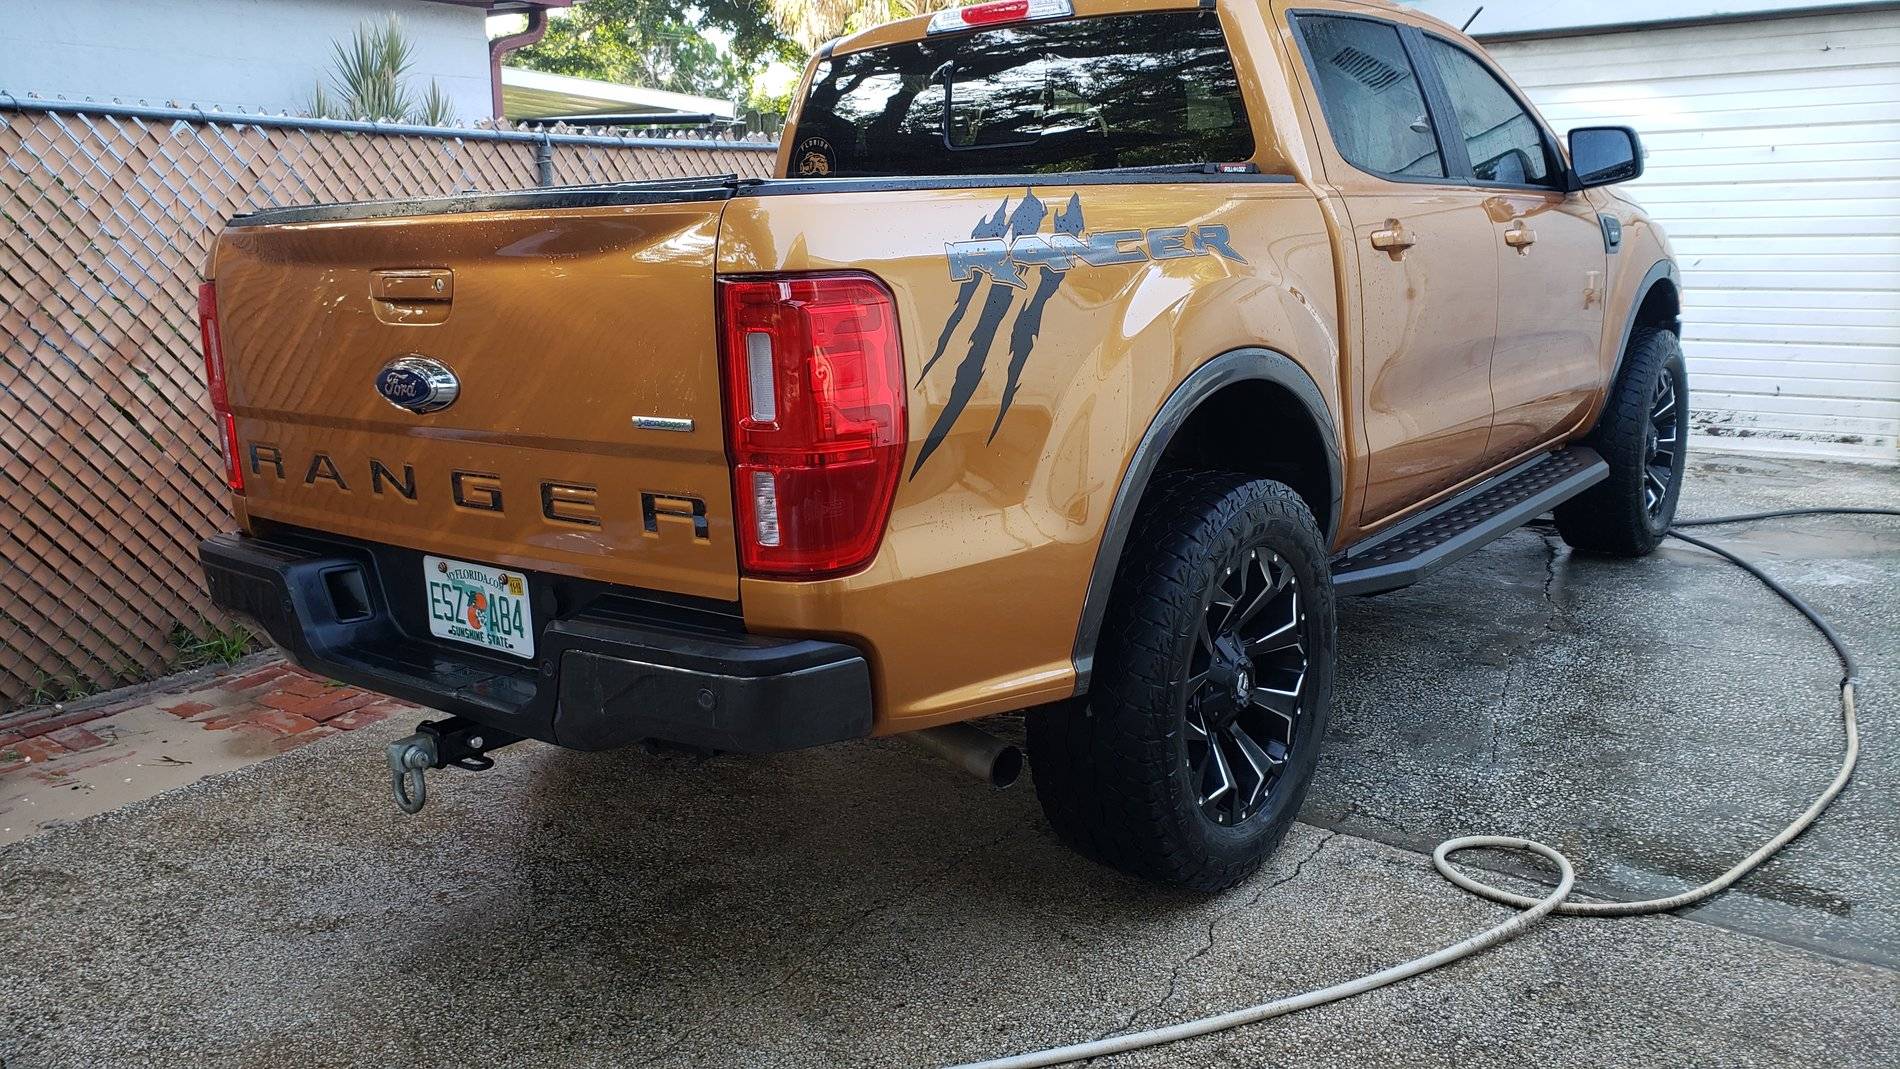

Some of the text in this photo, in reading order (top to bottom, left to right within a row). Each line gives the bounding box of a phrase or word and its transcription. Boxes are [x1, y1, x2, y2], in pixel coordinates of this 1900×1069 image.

[384, 372, 418, 397] Ford
[249, 442, 710, 543] RANGER
[430, 581, 466, 625] ESZ
[451, 625, 510, 649] SUNSHINE STATE
